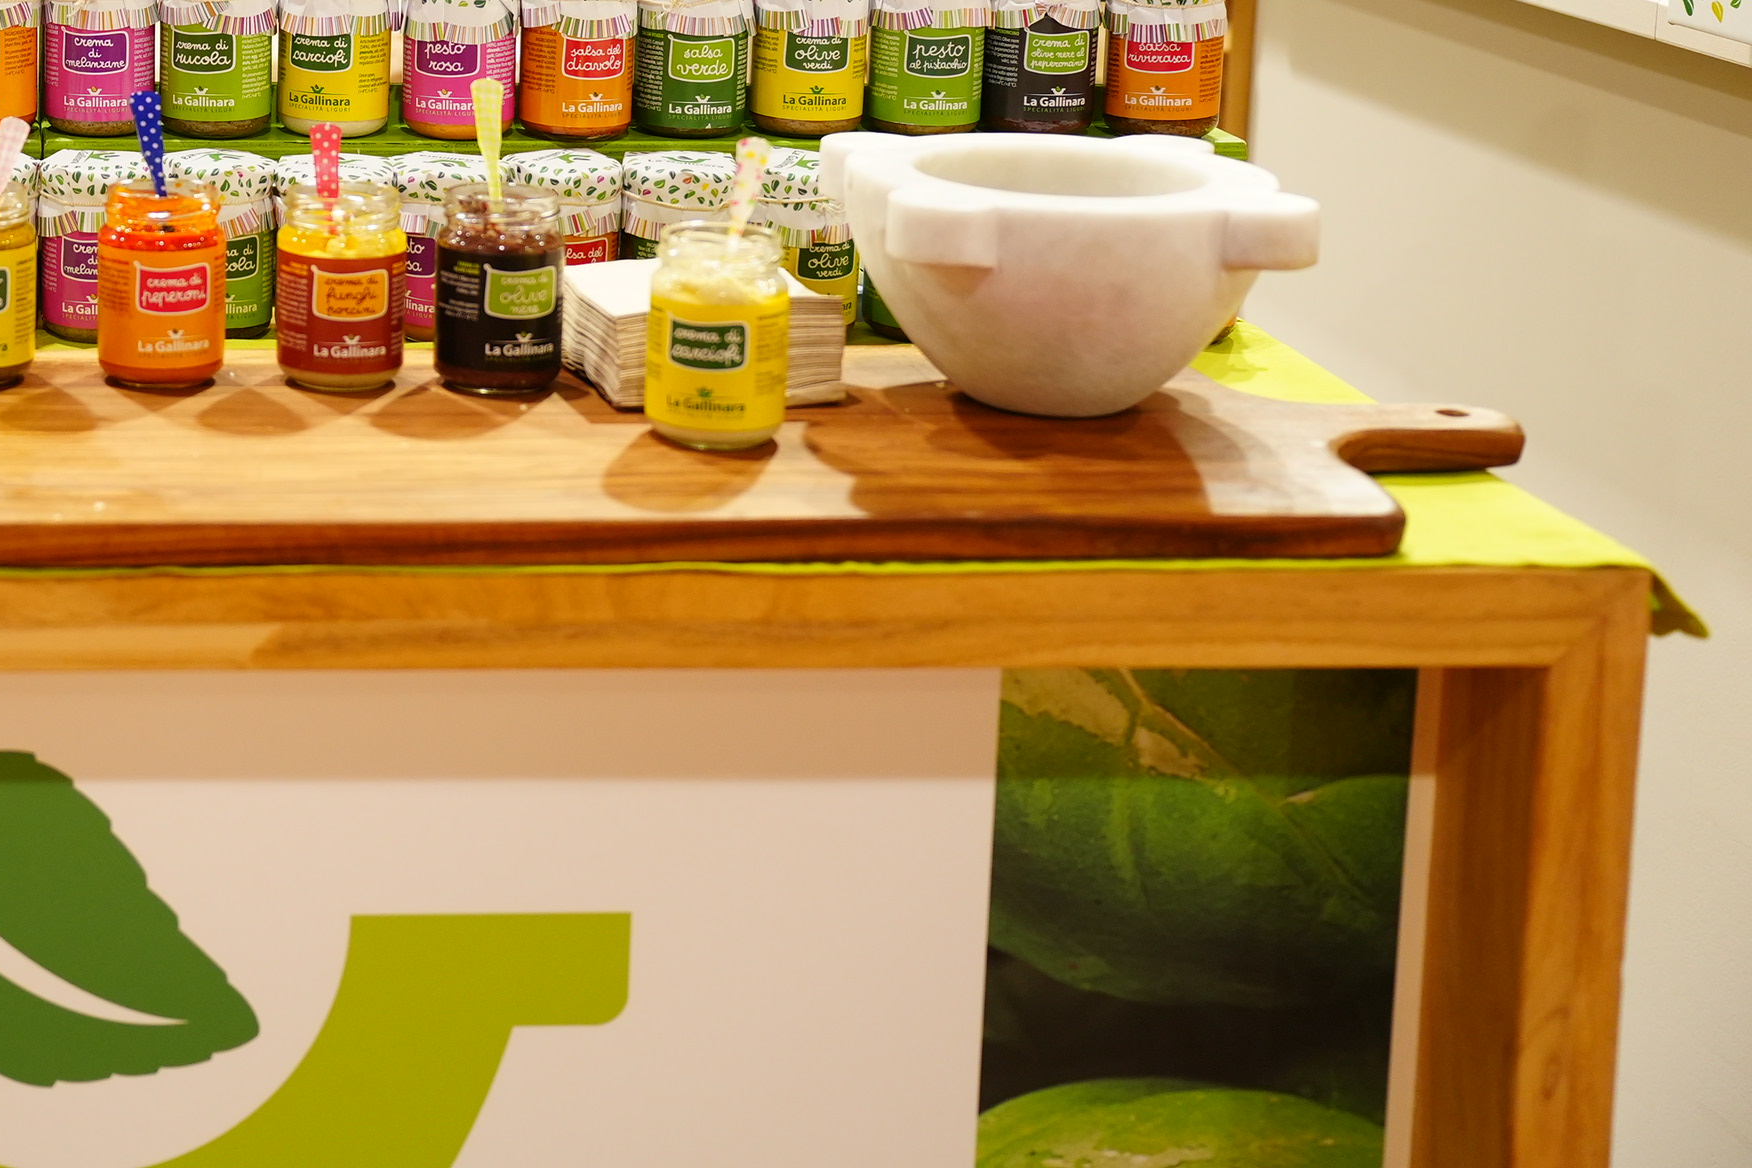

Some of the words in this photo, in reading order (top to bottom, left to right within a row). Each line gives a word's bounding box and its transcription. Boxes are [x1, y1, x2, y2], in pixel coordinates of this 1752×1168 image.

[75, 38, 114, 48] crema
[89, 48, 101, 58] di
[571, 47, 599, 57] salsa
[605, 45, 620, 57] del
[66, 58, 126, 70] melanzane
[567, 56, 620, 71] diavolo
[1129, 52, 1190, 64] rivierasca
[64, 96, 74, 106] La
[77, 95, 127, 107] Gallinara
[562, 102, 573, 112] La
[575, 101, 622, 113] Gallinara
[1125, 96, 1136, 105] La
[1138, 95, 1192, 108] Gallinara
[138, 341, 152, 351] La
[154, 339, 208, 352] Gallinara
[314, 345, 328, 355] La
[330, 344, 386, 358] Gallinara
[485, 343, 499, 354] La
[502, 342, 553, 355] Gallinara
